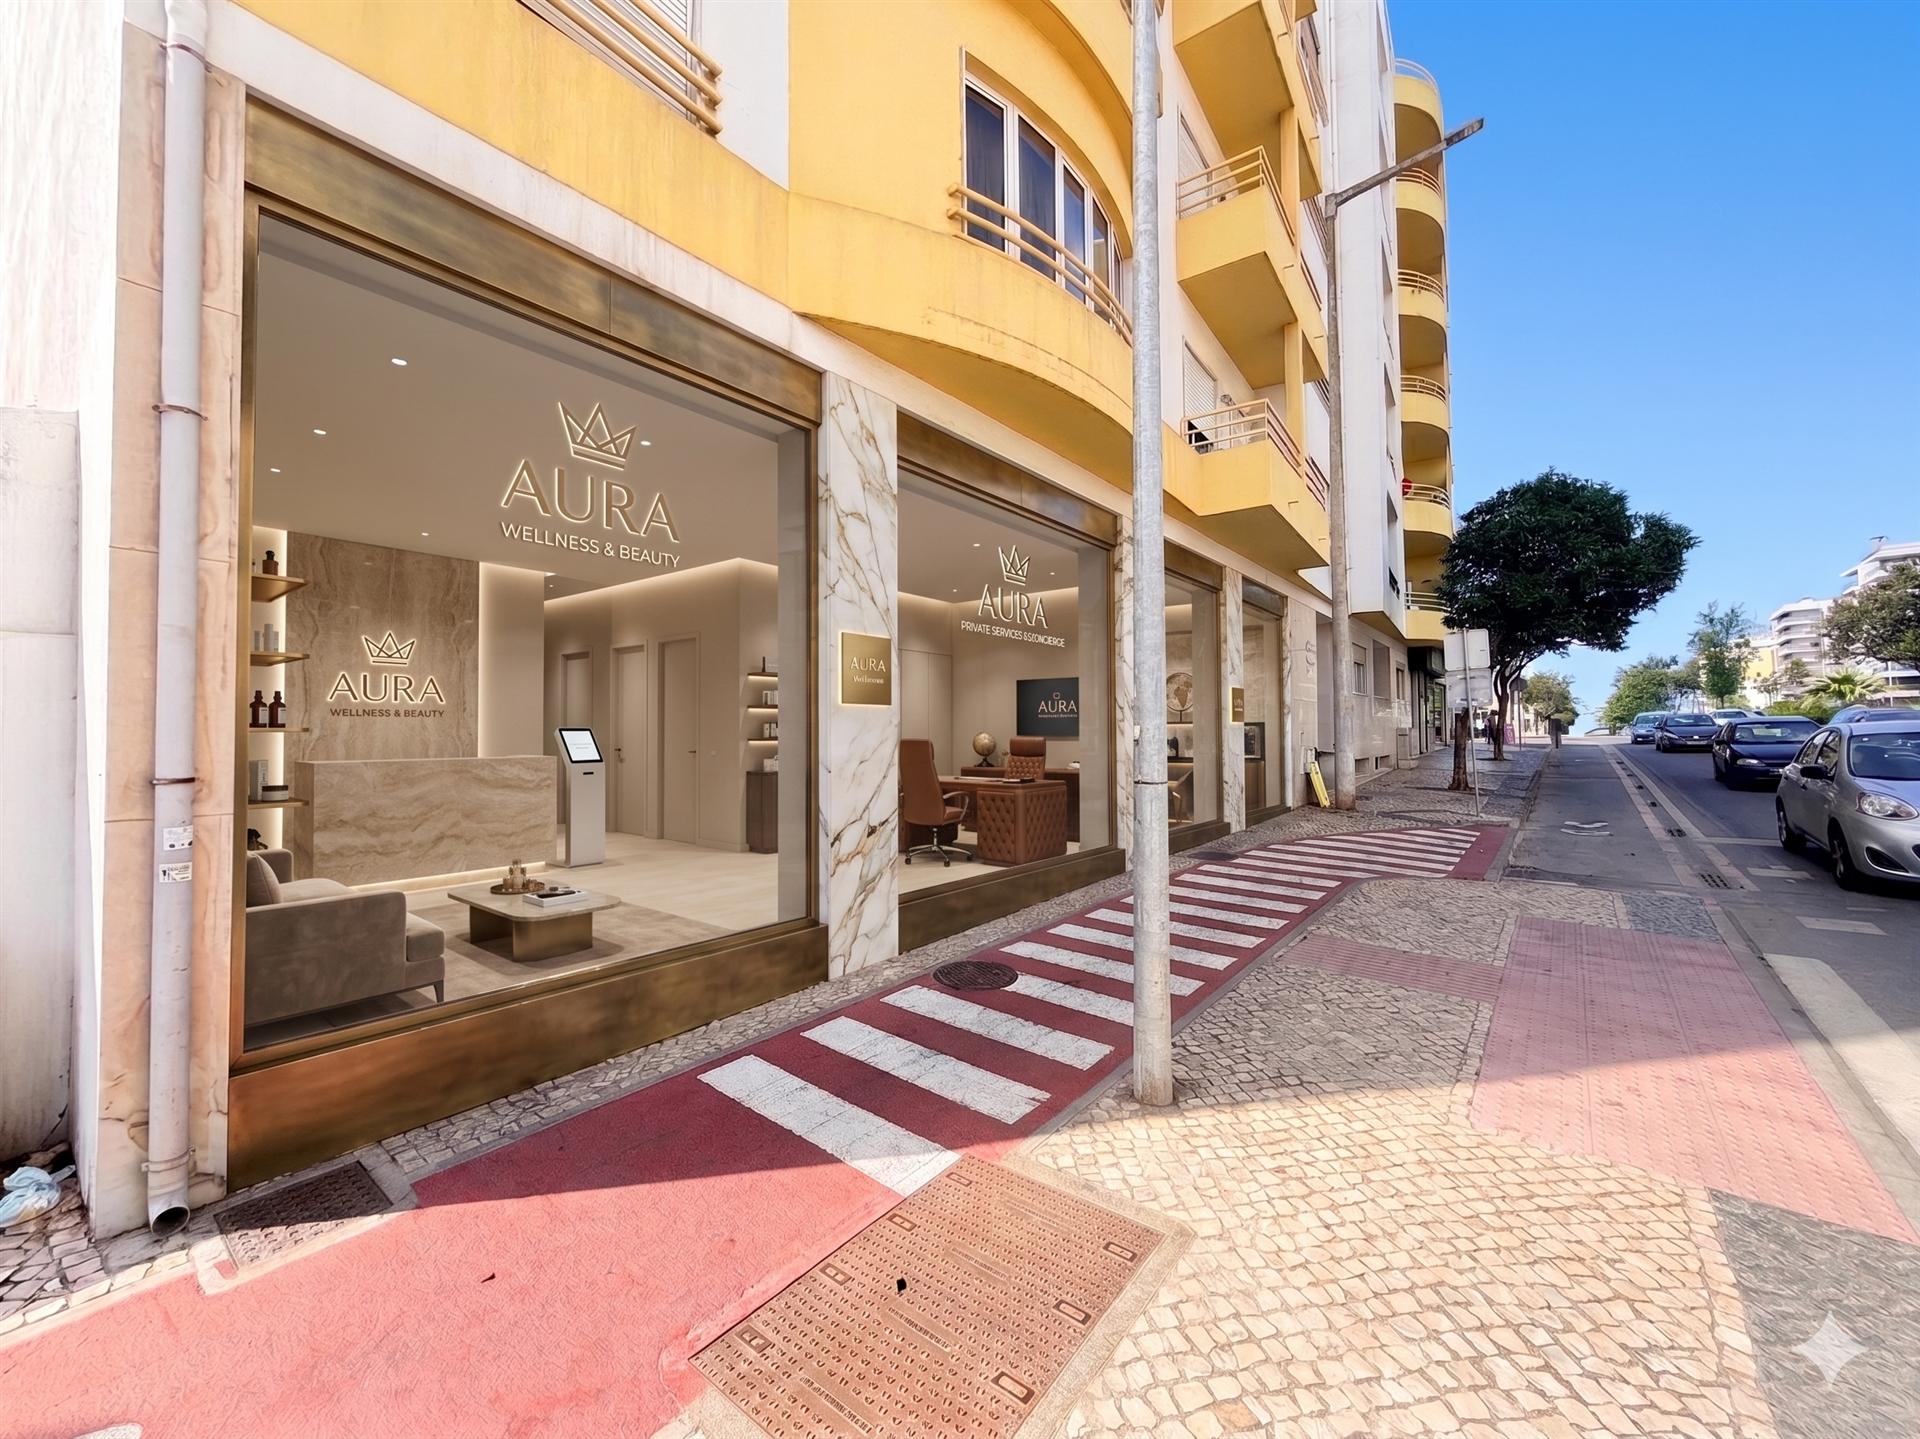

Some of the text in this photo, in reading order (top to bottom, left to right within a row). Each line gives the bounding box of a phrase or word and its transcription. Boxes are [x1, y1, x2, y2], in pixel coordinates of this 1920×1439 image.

[500, 458, 681, 544] AURA
[500, 521, 681, 568] WELLNESS & BEAUTY
[978, 583, 1049, 629] AURA
[960, 620, 991, 635] PRIVATE
[991, 626, 1023, 640] SERVICES
[850, 656, 886, 673] AURA
[328, 671, 446, 704] AURA
[329, 707, 445, 718] WELLNESS & BEAUTY
[1038, 700, 1078, 713] AURA
